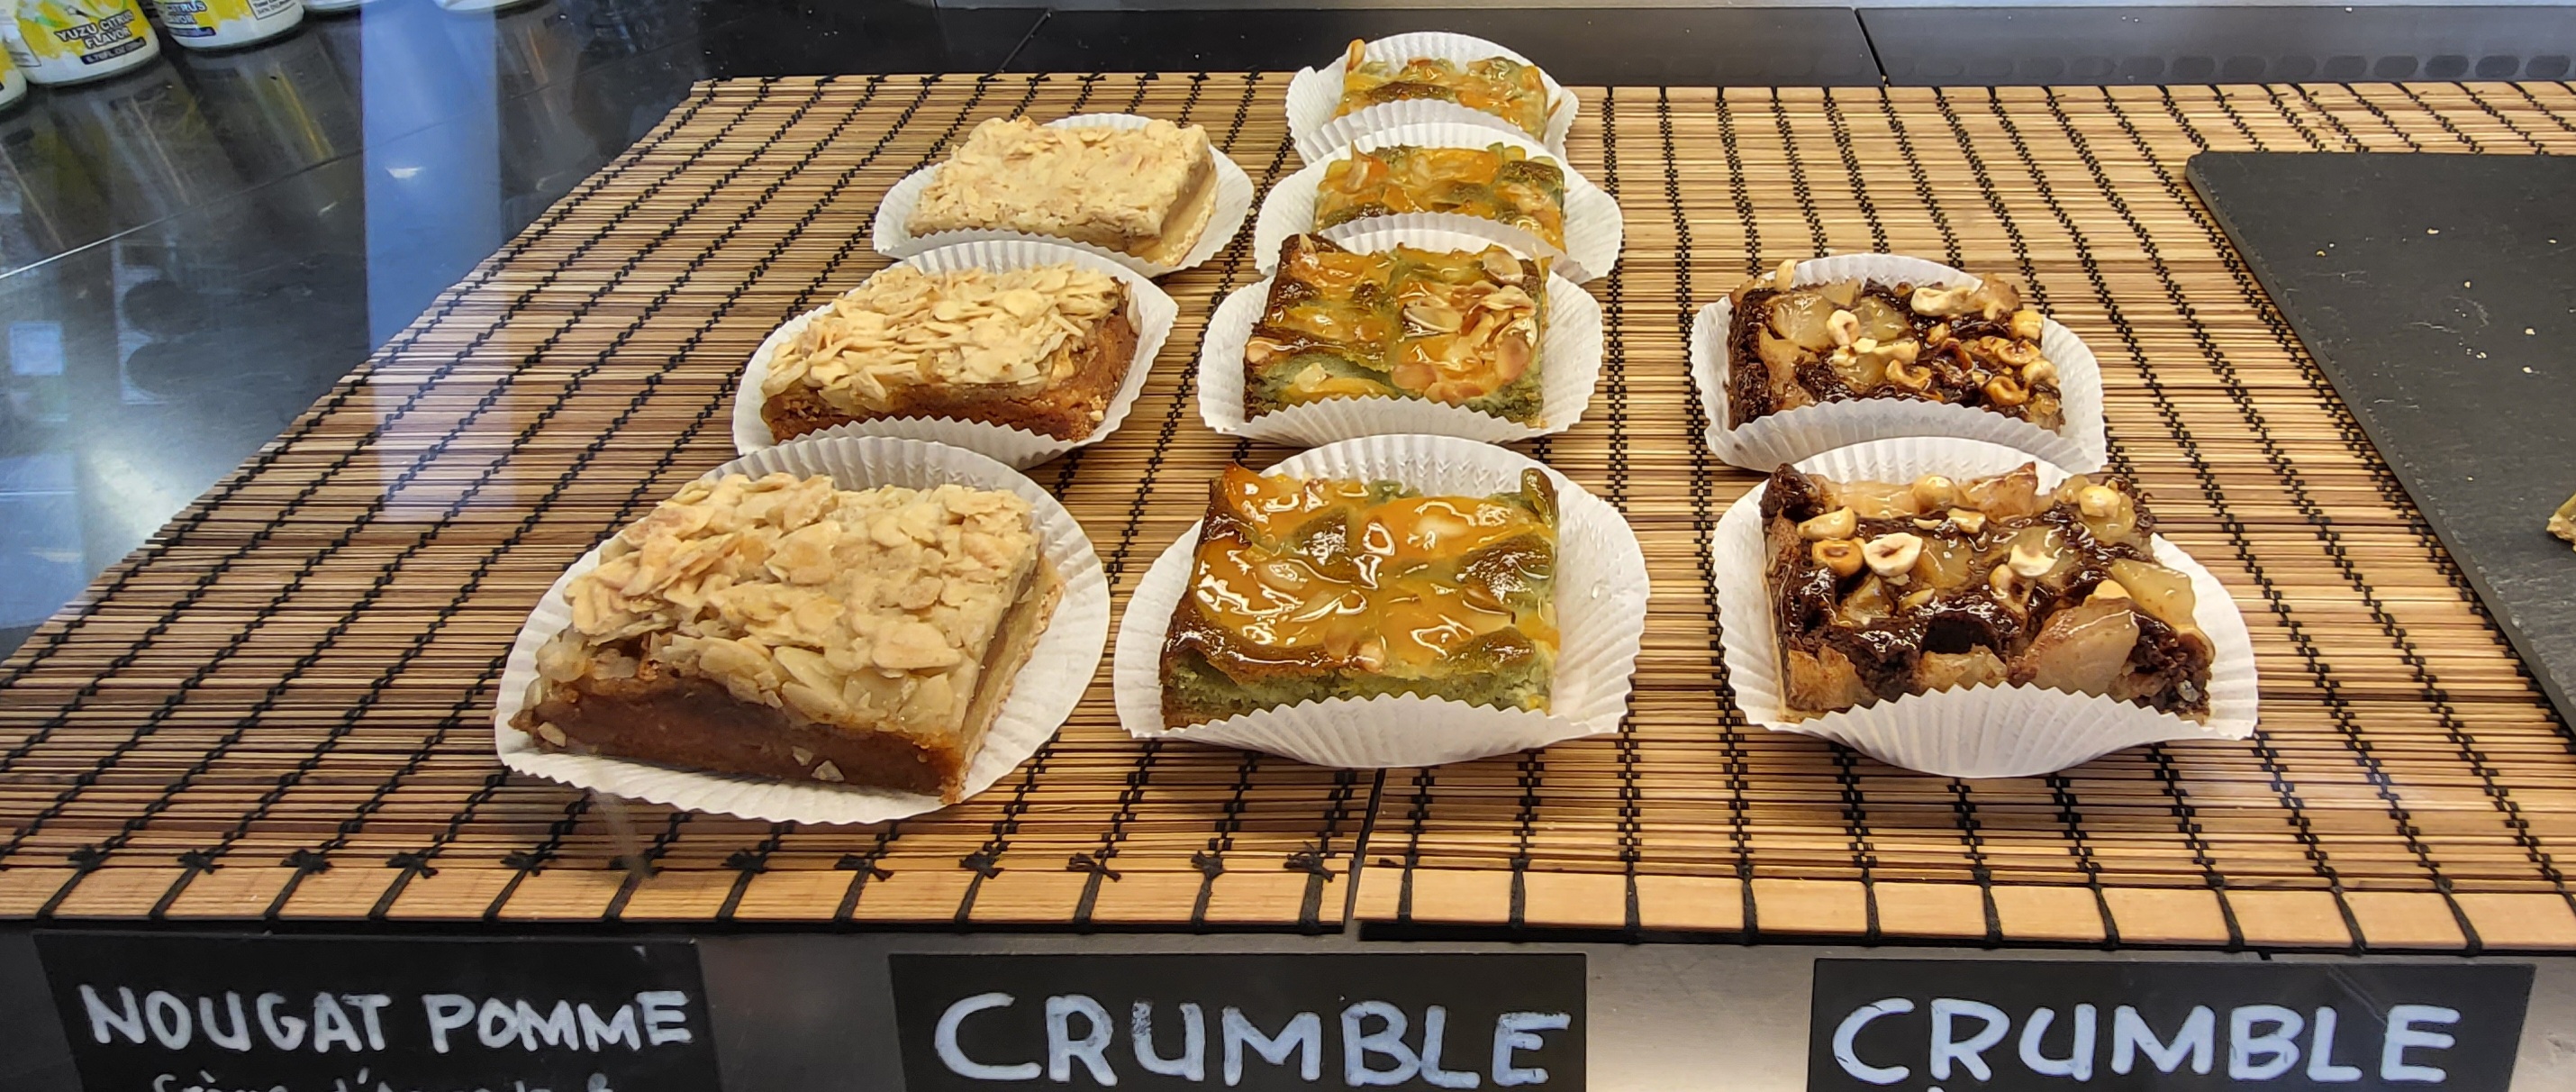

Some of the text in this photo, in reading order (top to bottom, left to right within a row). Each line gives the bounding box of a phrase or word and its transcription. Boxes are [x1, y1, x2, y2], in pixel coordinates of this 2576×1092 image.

[55, 10, 133, 41] YUZU CITRUS
[85, 27, 131, 49] FLAVOR
[79, 985, 692, 1052] NOUGAT POMME
[934, 992, 1571, 1088] CRUMBLE
[1833, 998, 2460, 1083] CRUMBLE
